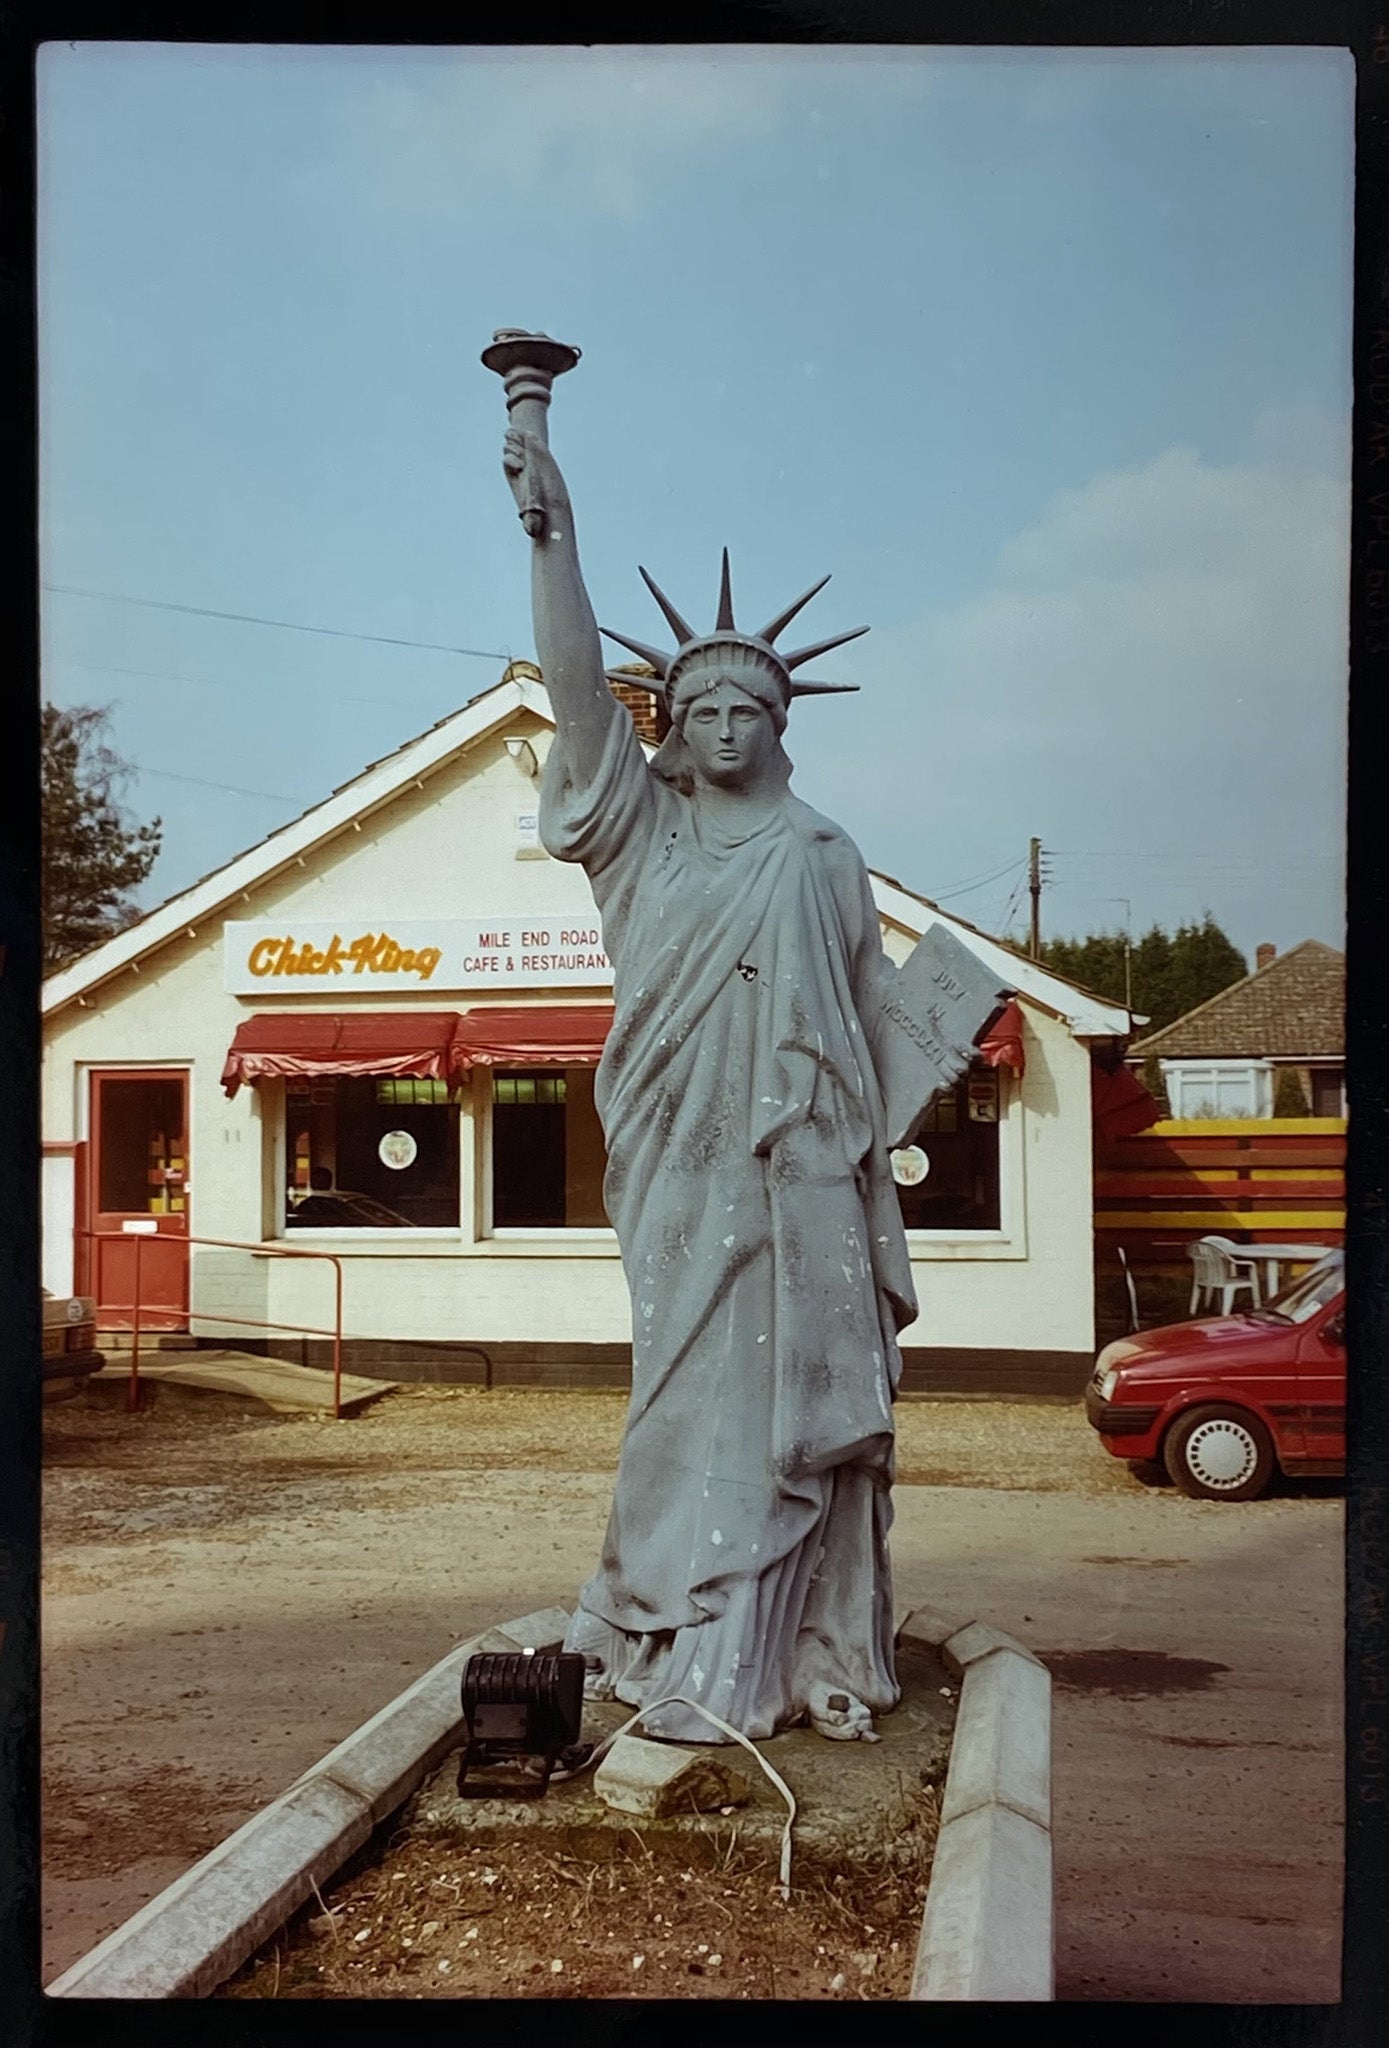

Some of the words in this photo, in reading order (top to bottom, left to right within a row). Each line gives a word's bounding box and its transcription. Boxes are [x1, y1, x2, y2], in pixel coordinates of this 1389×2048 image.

[479, 932, 511, 948] MILE
[521, 931, 550, 947] END
[560, 930, 599, 946] ROAD
[463, 956, 499, 972] CAFE
[505, 957, 514, 971] &
[522, 953, 613, 971] RESTAURAN
